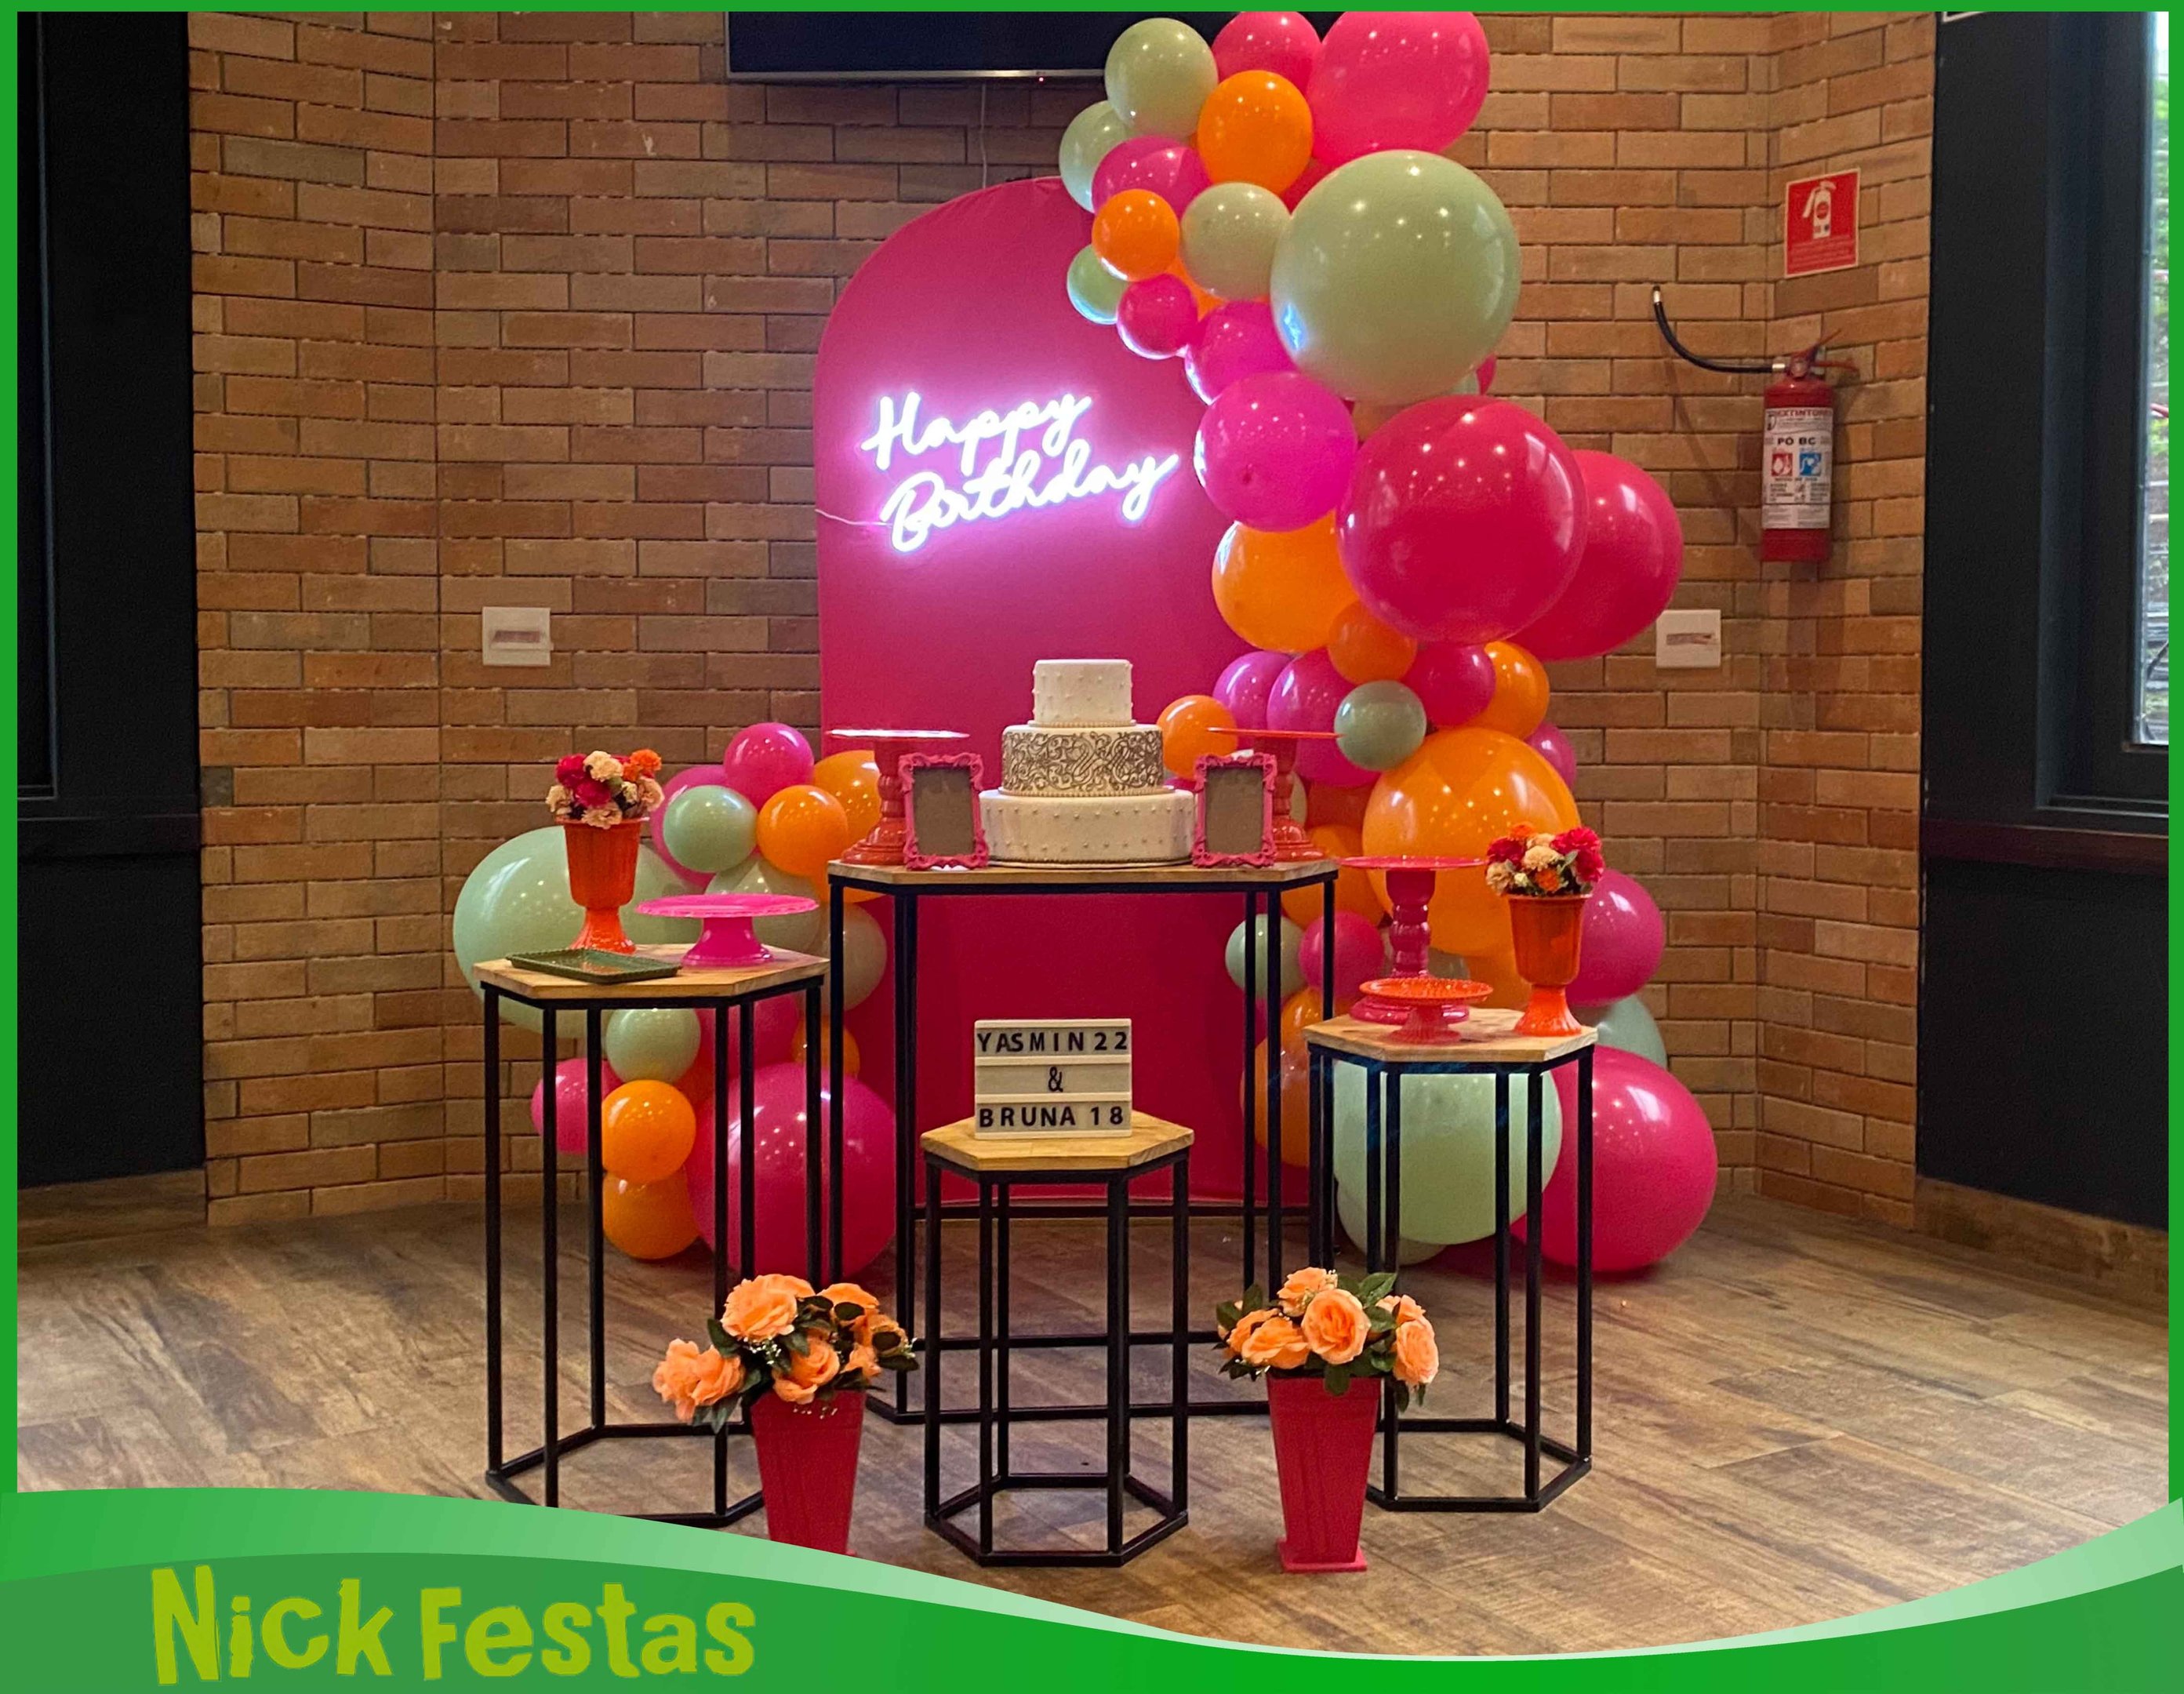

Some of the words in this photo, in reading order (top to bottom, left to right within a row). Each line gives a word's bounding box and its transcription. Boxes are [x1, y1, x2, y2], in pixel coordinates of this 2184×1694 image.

[862, 391, 1092, 475] Happy
[1799, 437, 1816, 445] BC
[880, 438, 1179, 551] Birthday
[977, 1032, 1084, 1052] YASMIN
[1094, 1031, 1127, 1050] 22
[1048, 1066, 1063, 1092] &
[979, 1107, 1076, 1128] BRUNA
[1090, 1106, 1123, 1125] 18
